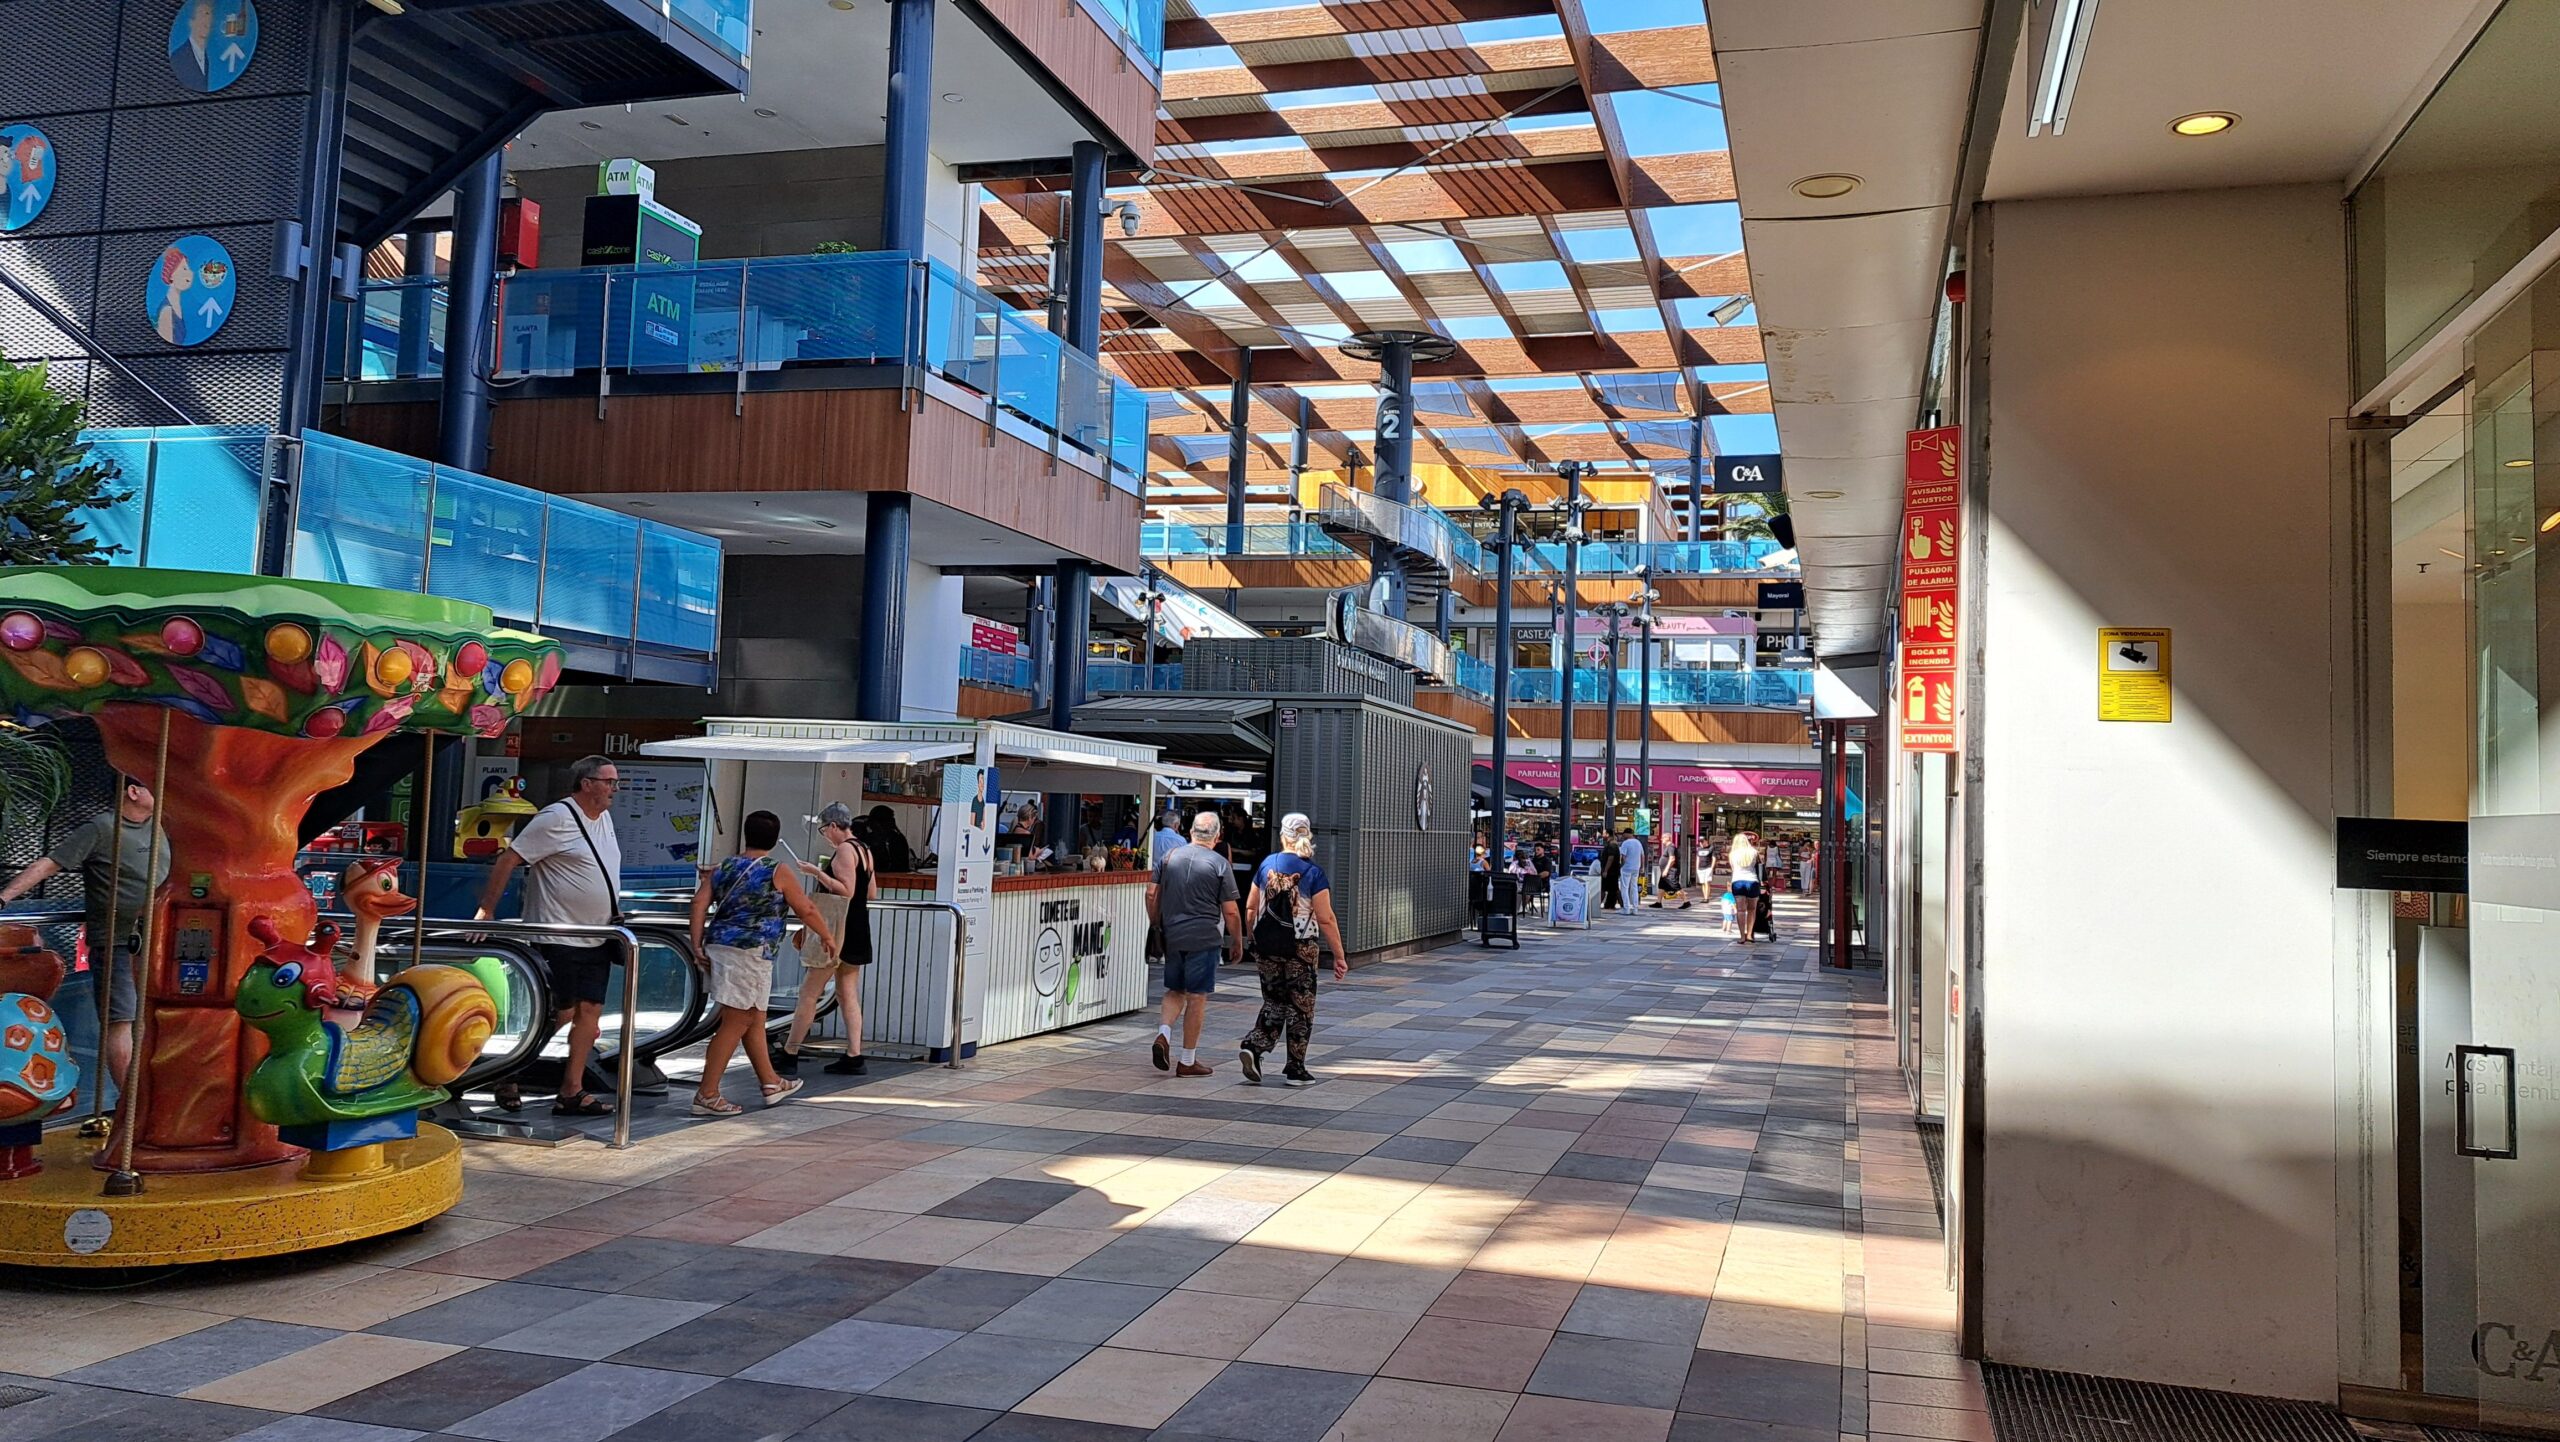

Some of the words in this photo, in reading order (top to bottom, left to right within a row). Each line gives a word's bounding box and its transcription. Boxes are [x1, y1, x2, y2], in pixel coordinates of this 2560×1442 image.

[607, 171, 630, 182] ATM
[636, 176, 653, 193] ATM
[648, 292, 680, 321] ATM
[516, 334, 531, 374] 1
[1383, 414, 1400, 439] 2
[1732, 465, 1764, 482] C&A
[1912, 486, 1954, 496] AVISADOR
[1912, 495, 1954, 505] ACUSTICO
[1909, 566, 1953, 576] PULSADOR
[1907, 578, 1918, 586] DE
[1920, 577, 1954, 586] ALARMA
[1380, 576, 1390, 600] 1
[1766, 636, 1813, 648] PHOE
[1937, 648, 1949, 656] DE
[1909, 658, 1951, 666] INCENDIO
[1904, 734, 1953, 744] EXTINTOR
[1761, 777, 1810, 787] PERFUMERY
[2366, 849, 2419, 864] Siempre
[1040, 900, 1069, 924] COMETE
[1069, 899, 1081, 920] UN
